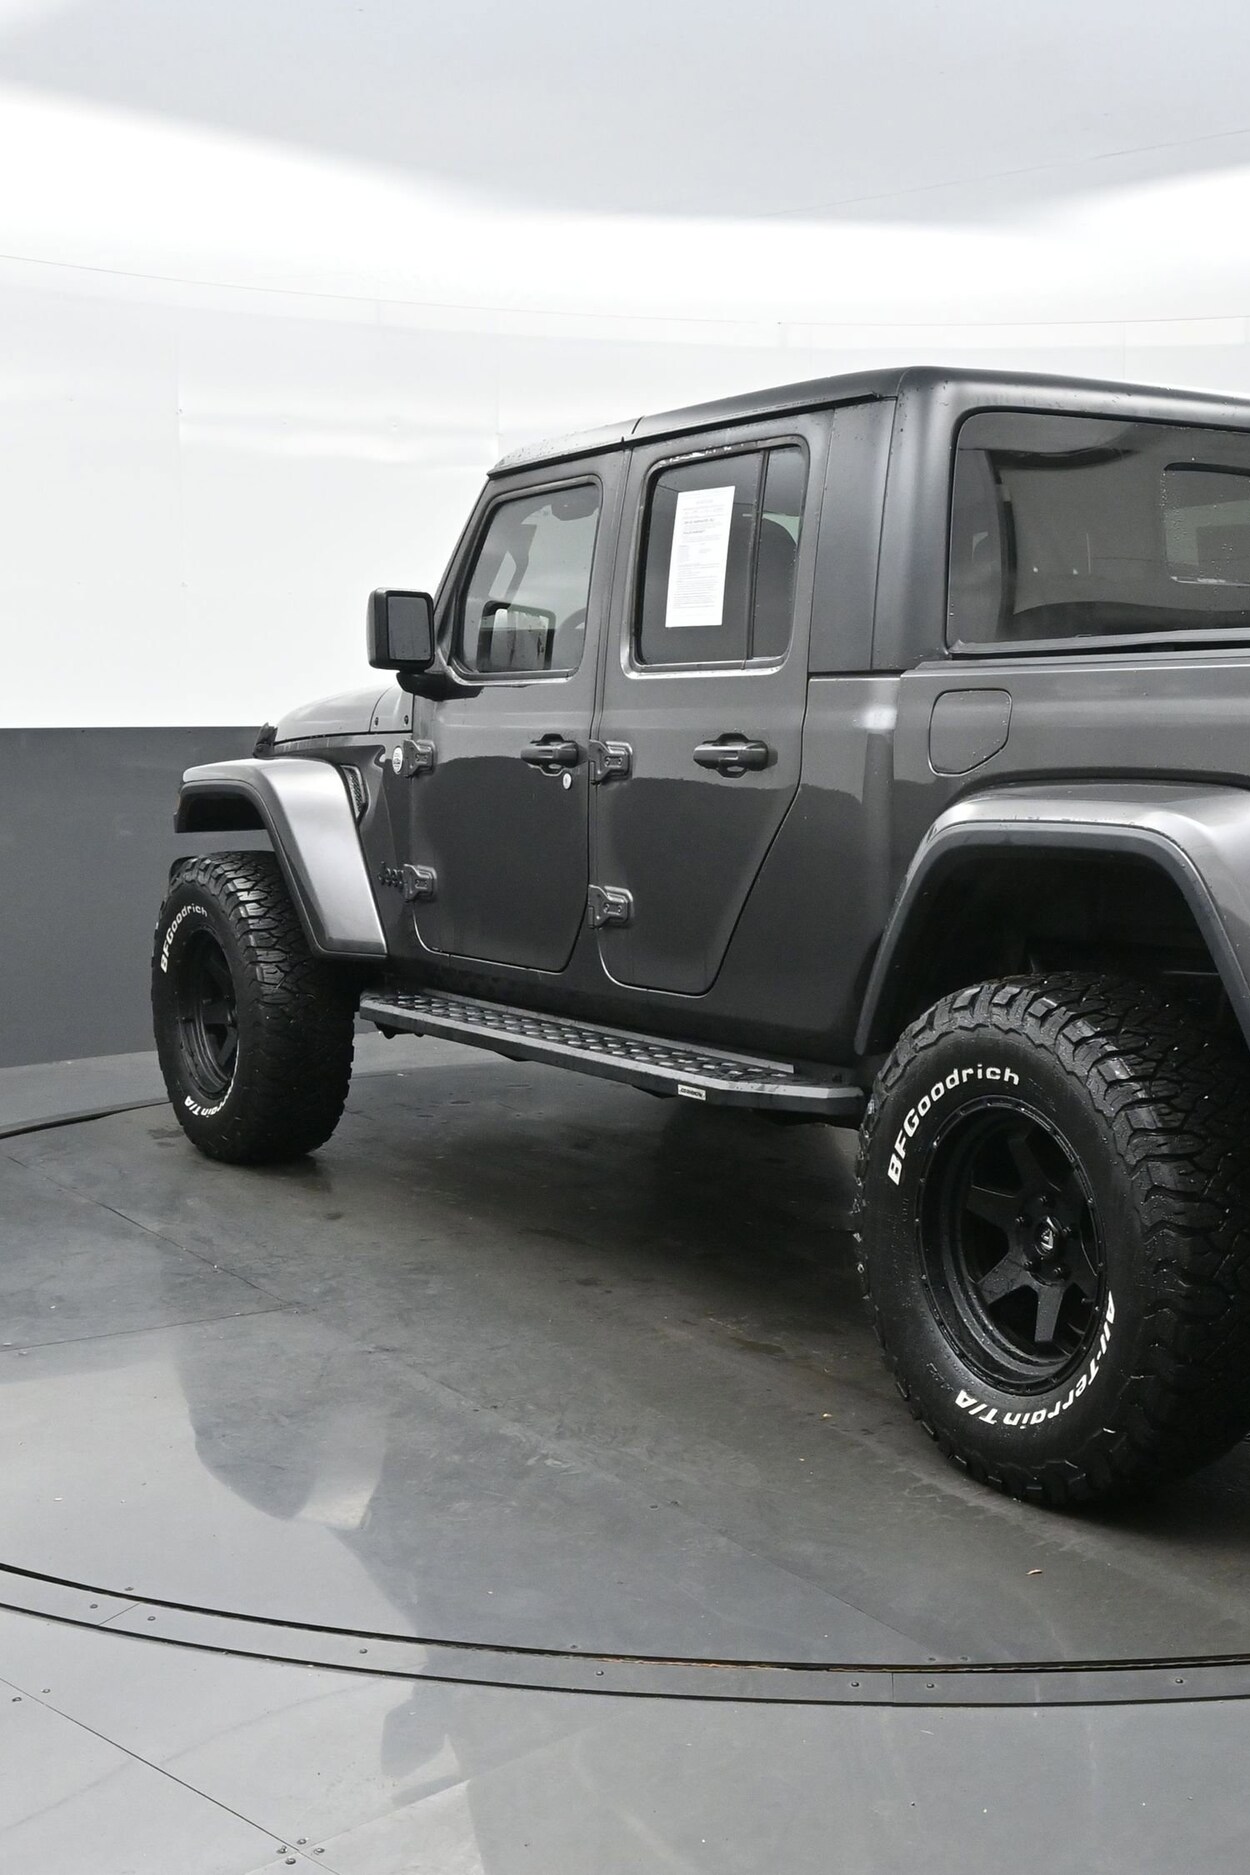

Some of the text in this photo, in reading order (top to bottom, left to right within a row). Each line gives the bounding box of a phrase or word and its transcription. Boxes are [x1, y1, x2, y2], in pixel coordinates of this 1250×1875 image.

[160, 903, 208, 973] BFGoodrich
[887, 1063, 1020, 1186] BFGoodrich
[954, 1290, 1116, 1430] All-Terrain T/A
